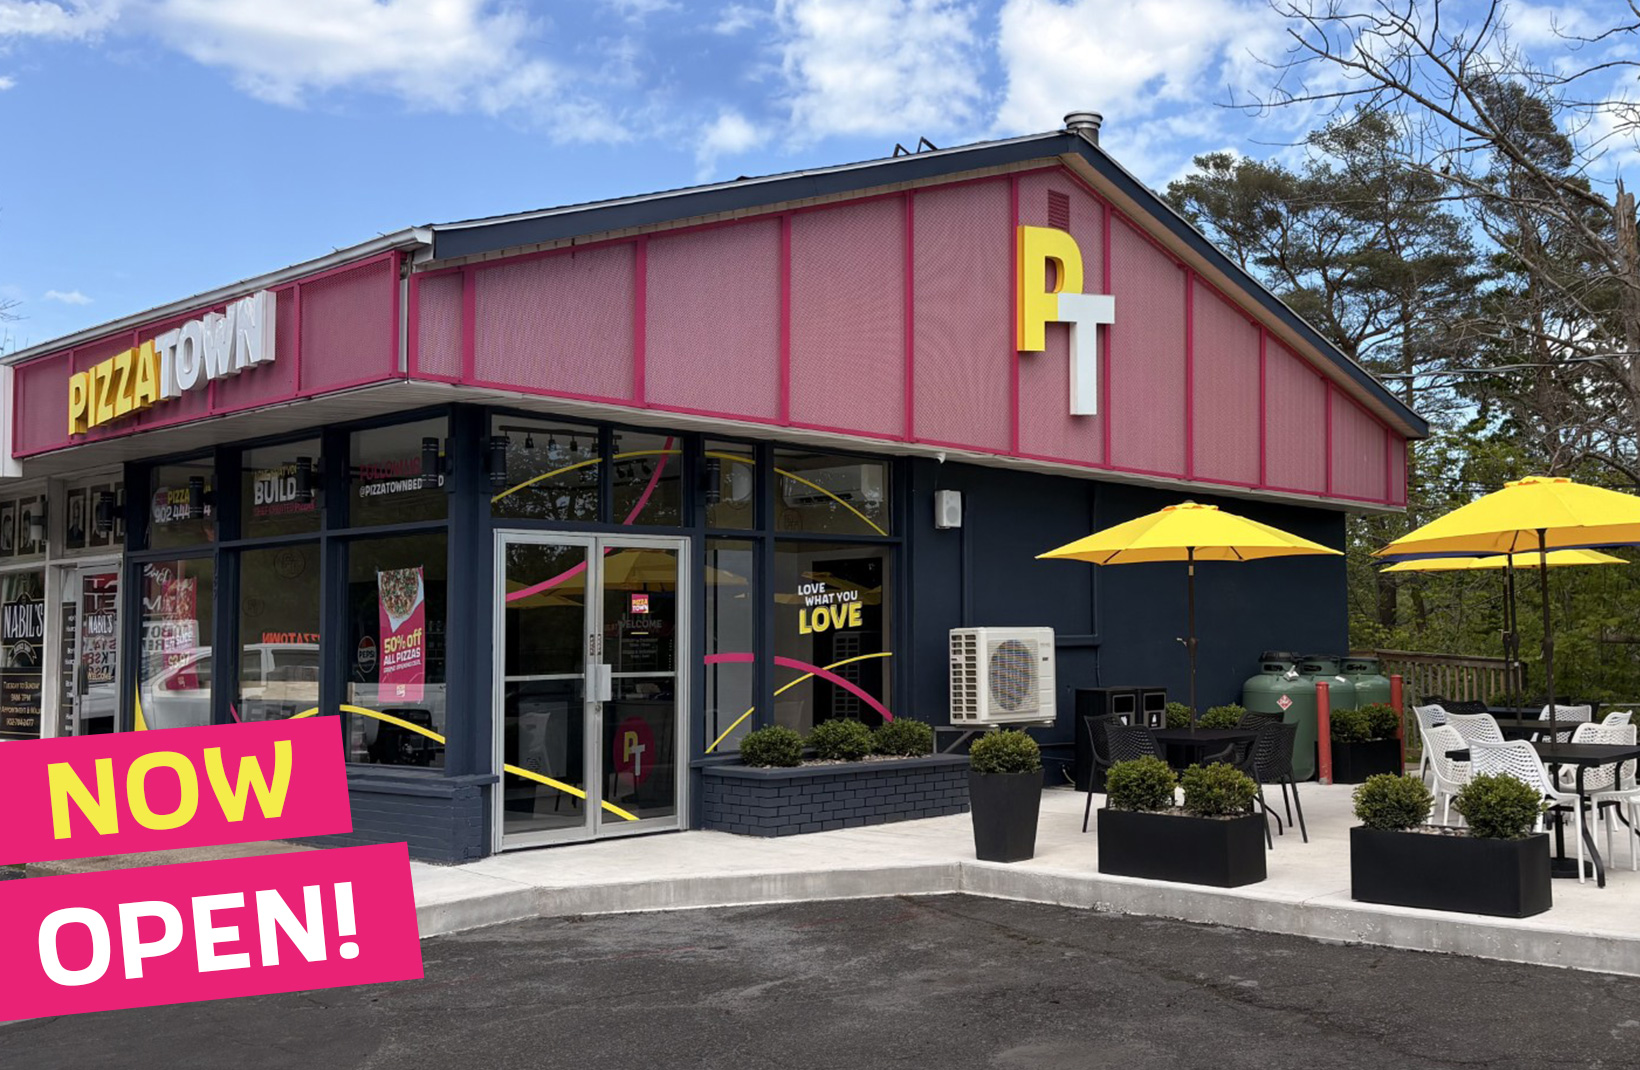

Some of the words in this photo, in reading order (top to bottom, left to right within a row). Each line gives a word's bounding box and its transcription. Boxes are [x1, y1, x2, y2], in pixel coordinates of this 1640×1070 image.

[254, 476, 297, 506] BUILD
[798, 583, 826, 596] LOVE
[805, 593, 835, 607] WHAT
[836, 590, 858, 603] YOU
[4, 603, 43, 638] NABIL'S
[618, 620, 663, 629] WELCOME
[799, 601, 863, 635] LOVE
[384, 635, 406, 654] 50%
[407, 628, 422, 648] off
[383, 653, 396, 667] ALL
[396, 647, 421, 663] PIZZAS
